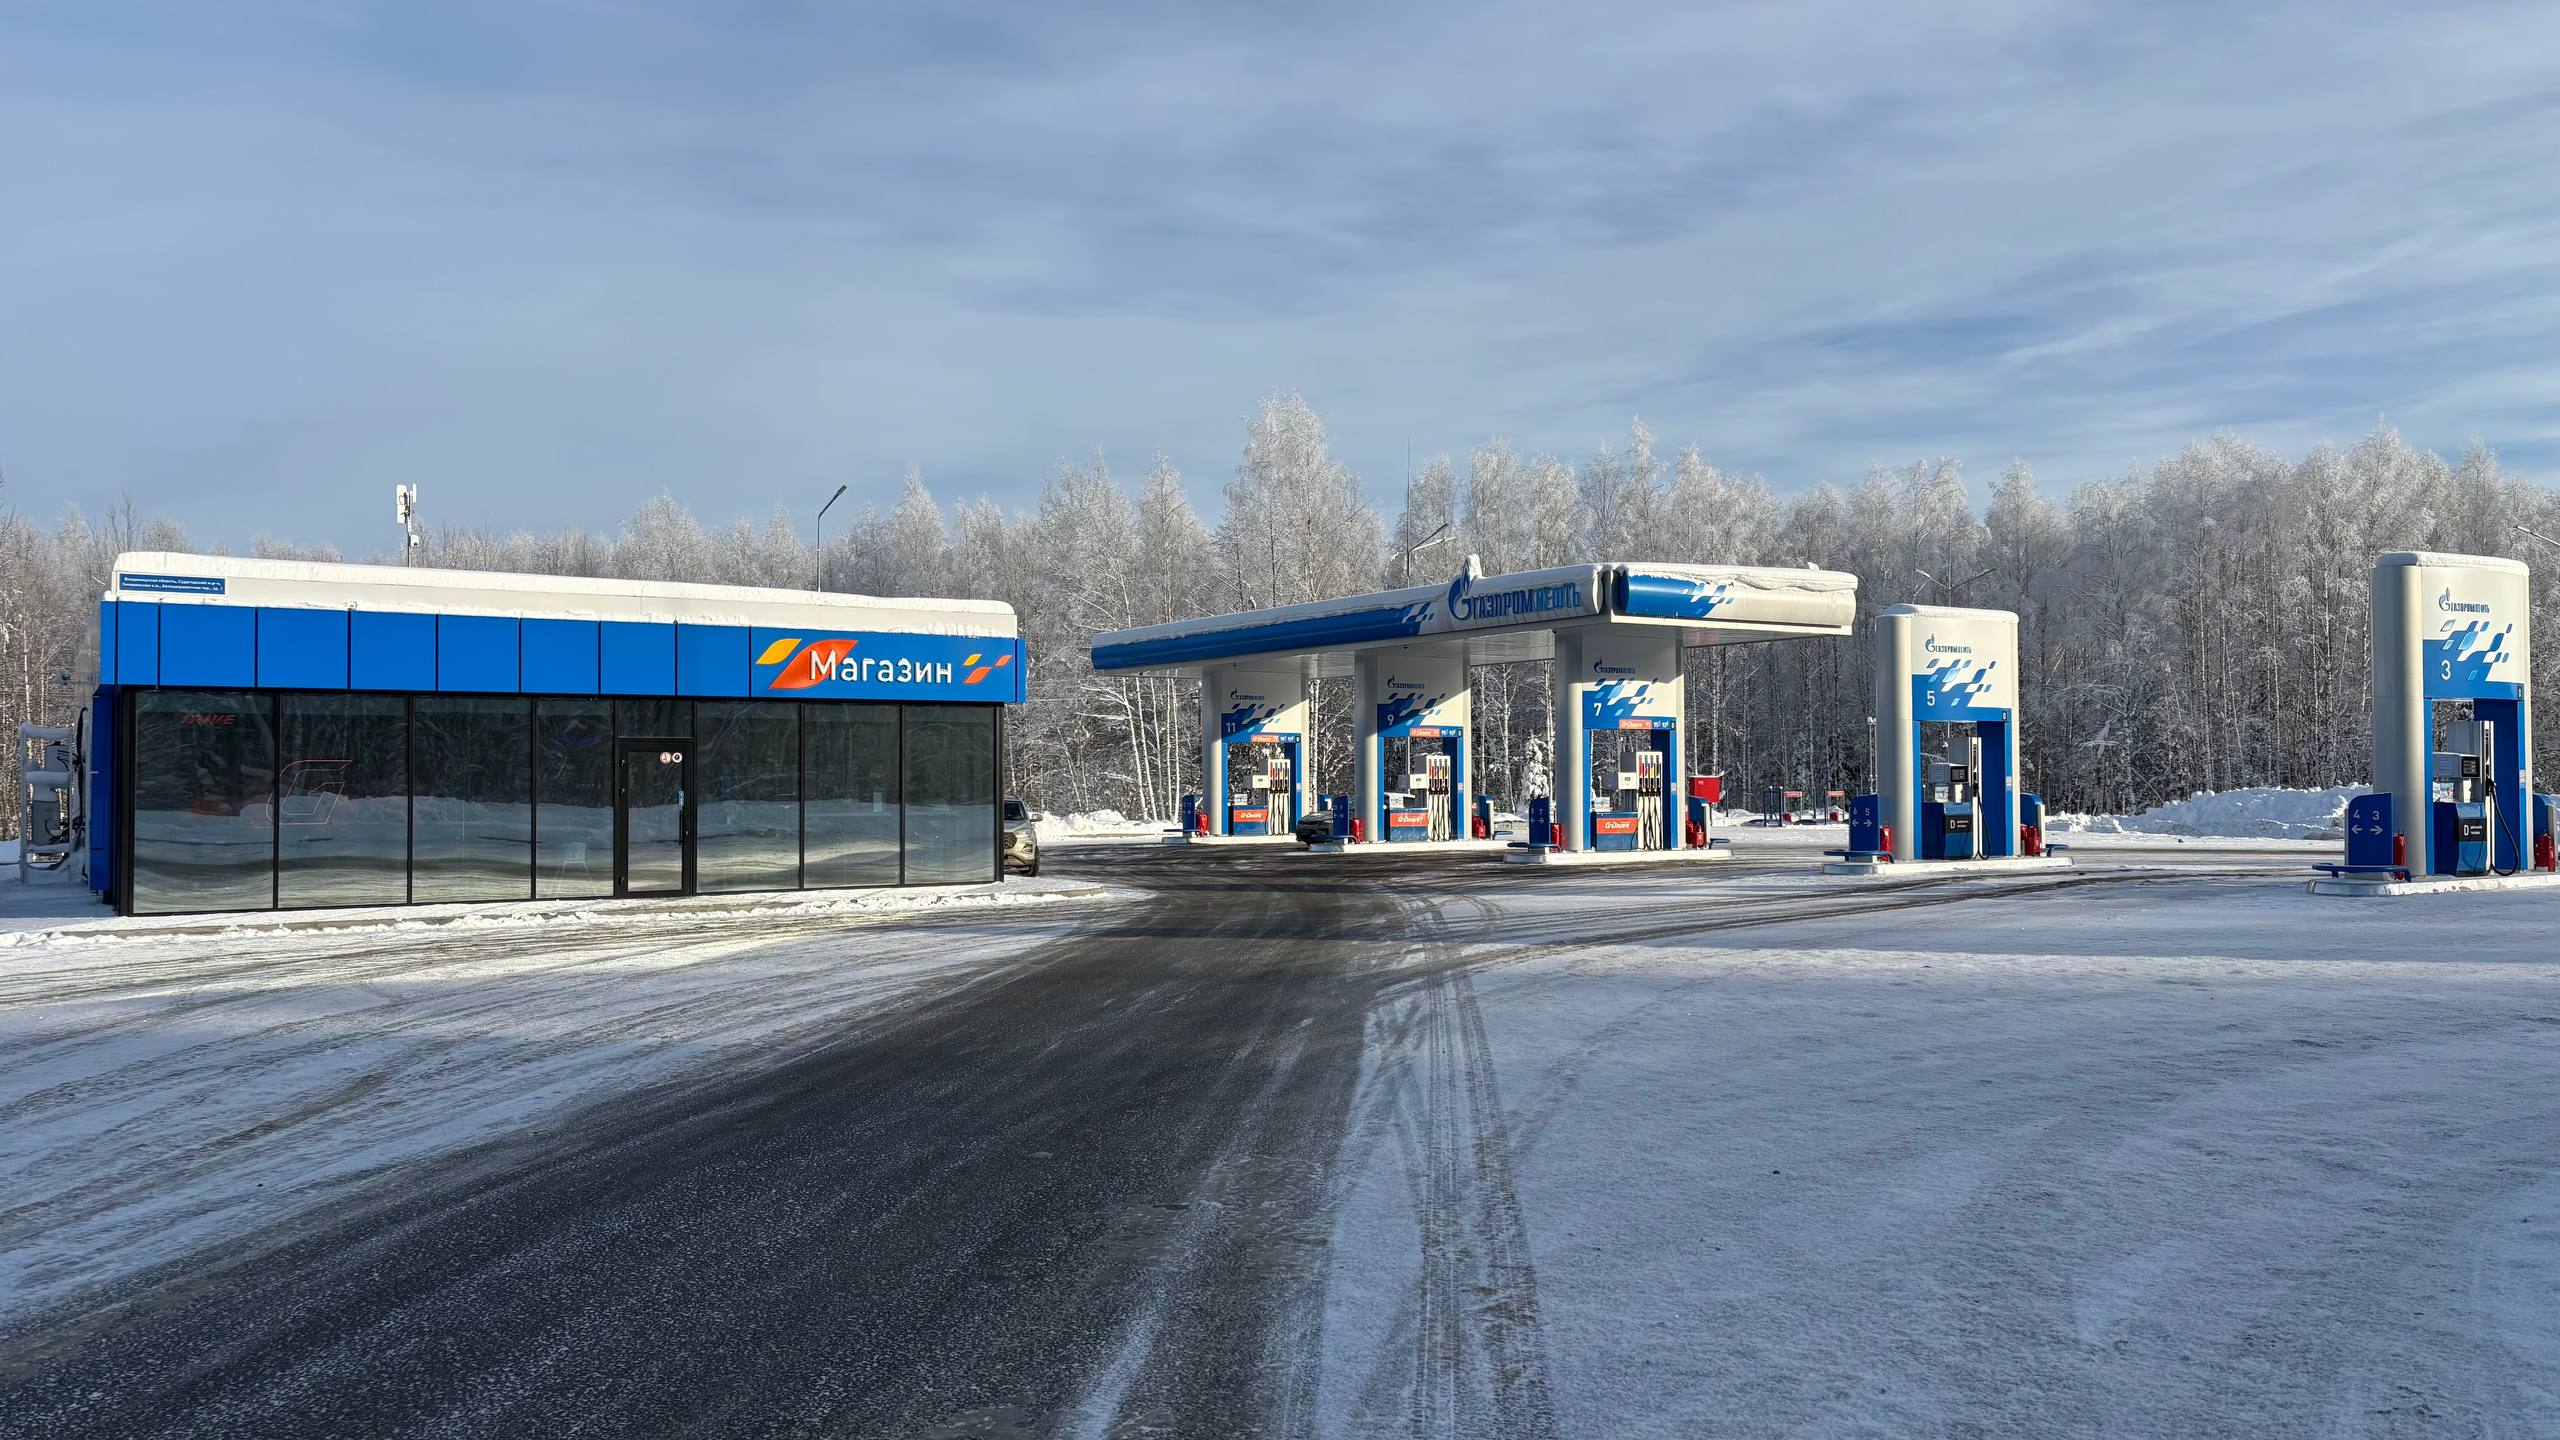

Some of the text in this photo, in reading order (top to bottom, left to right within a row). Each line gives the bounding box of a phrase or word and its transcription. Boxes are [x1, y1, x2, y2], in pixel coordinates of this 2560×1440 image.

[809, 650, 952, 684] Магазин
[2441, 659, 2451, 681] 3
[1926, 690, 1936, 706] 5
[1593, 702, 1602, 717] 7
[1387, 714, 1395, 726] 9
[1225, 722, 1236, 733] 11
[1865, 807, 1870, 816] 5
[2353, 809, 2380, 820] 4 3
[1950, 820, 1956, 829] D
[2463, 824, 2470, 836] D
